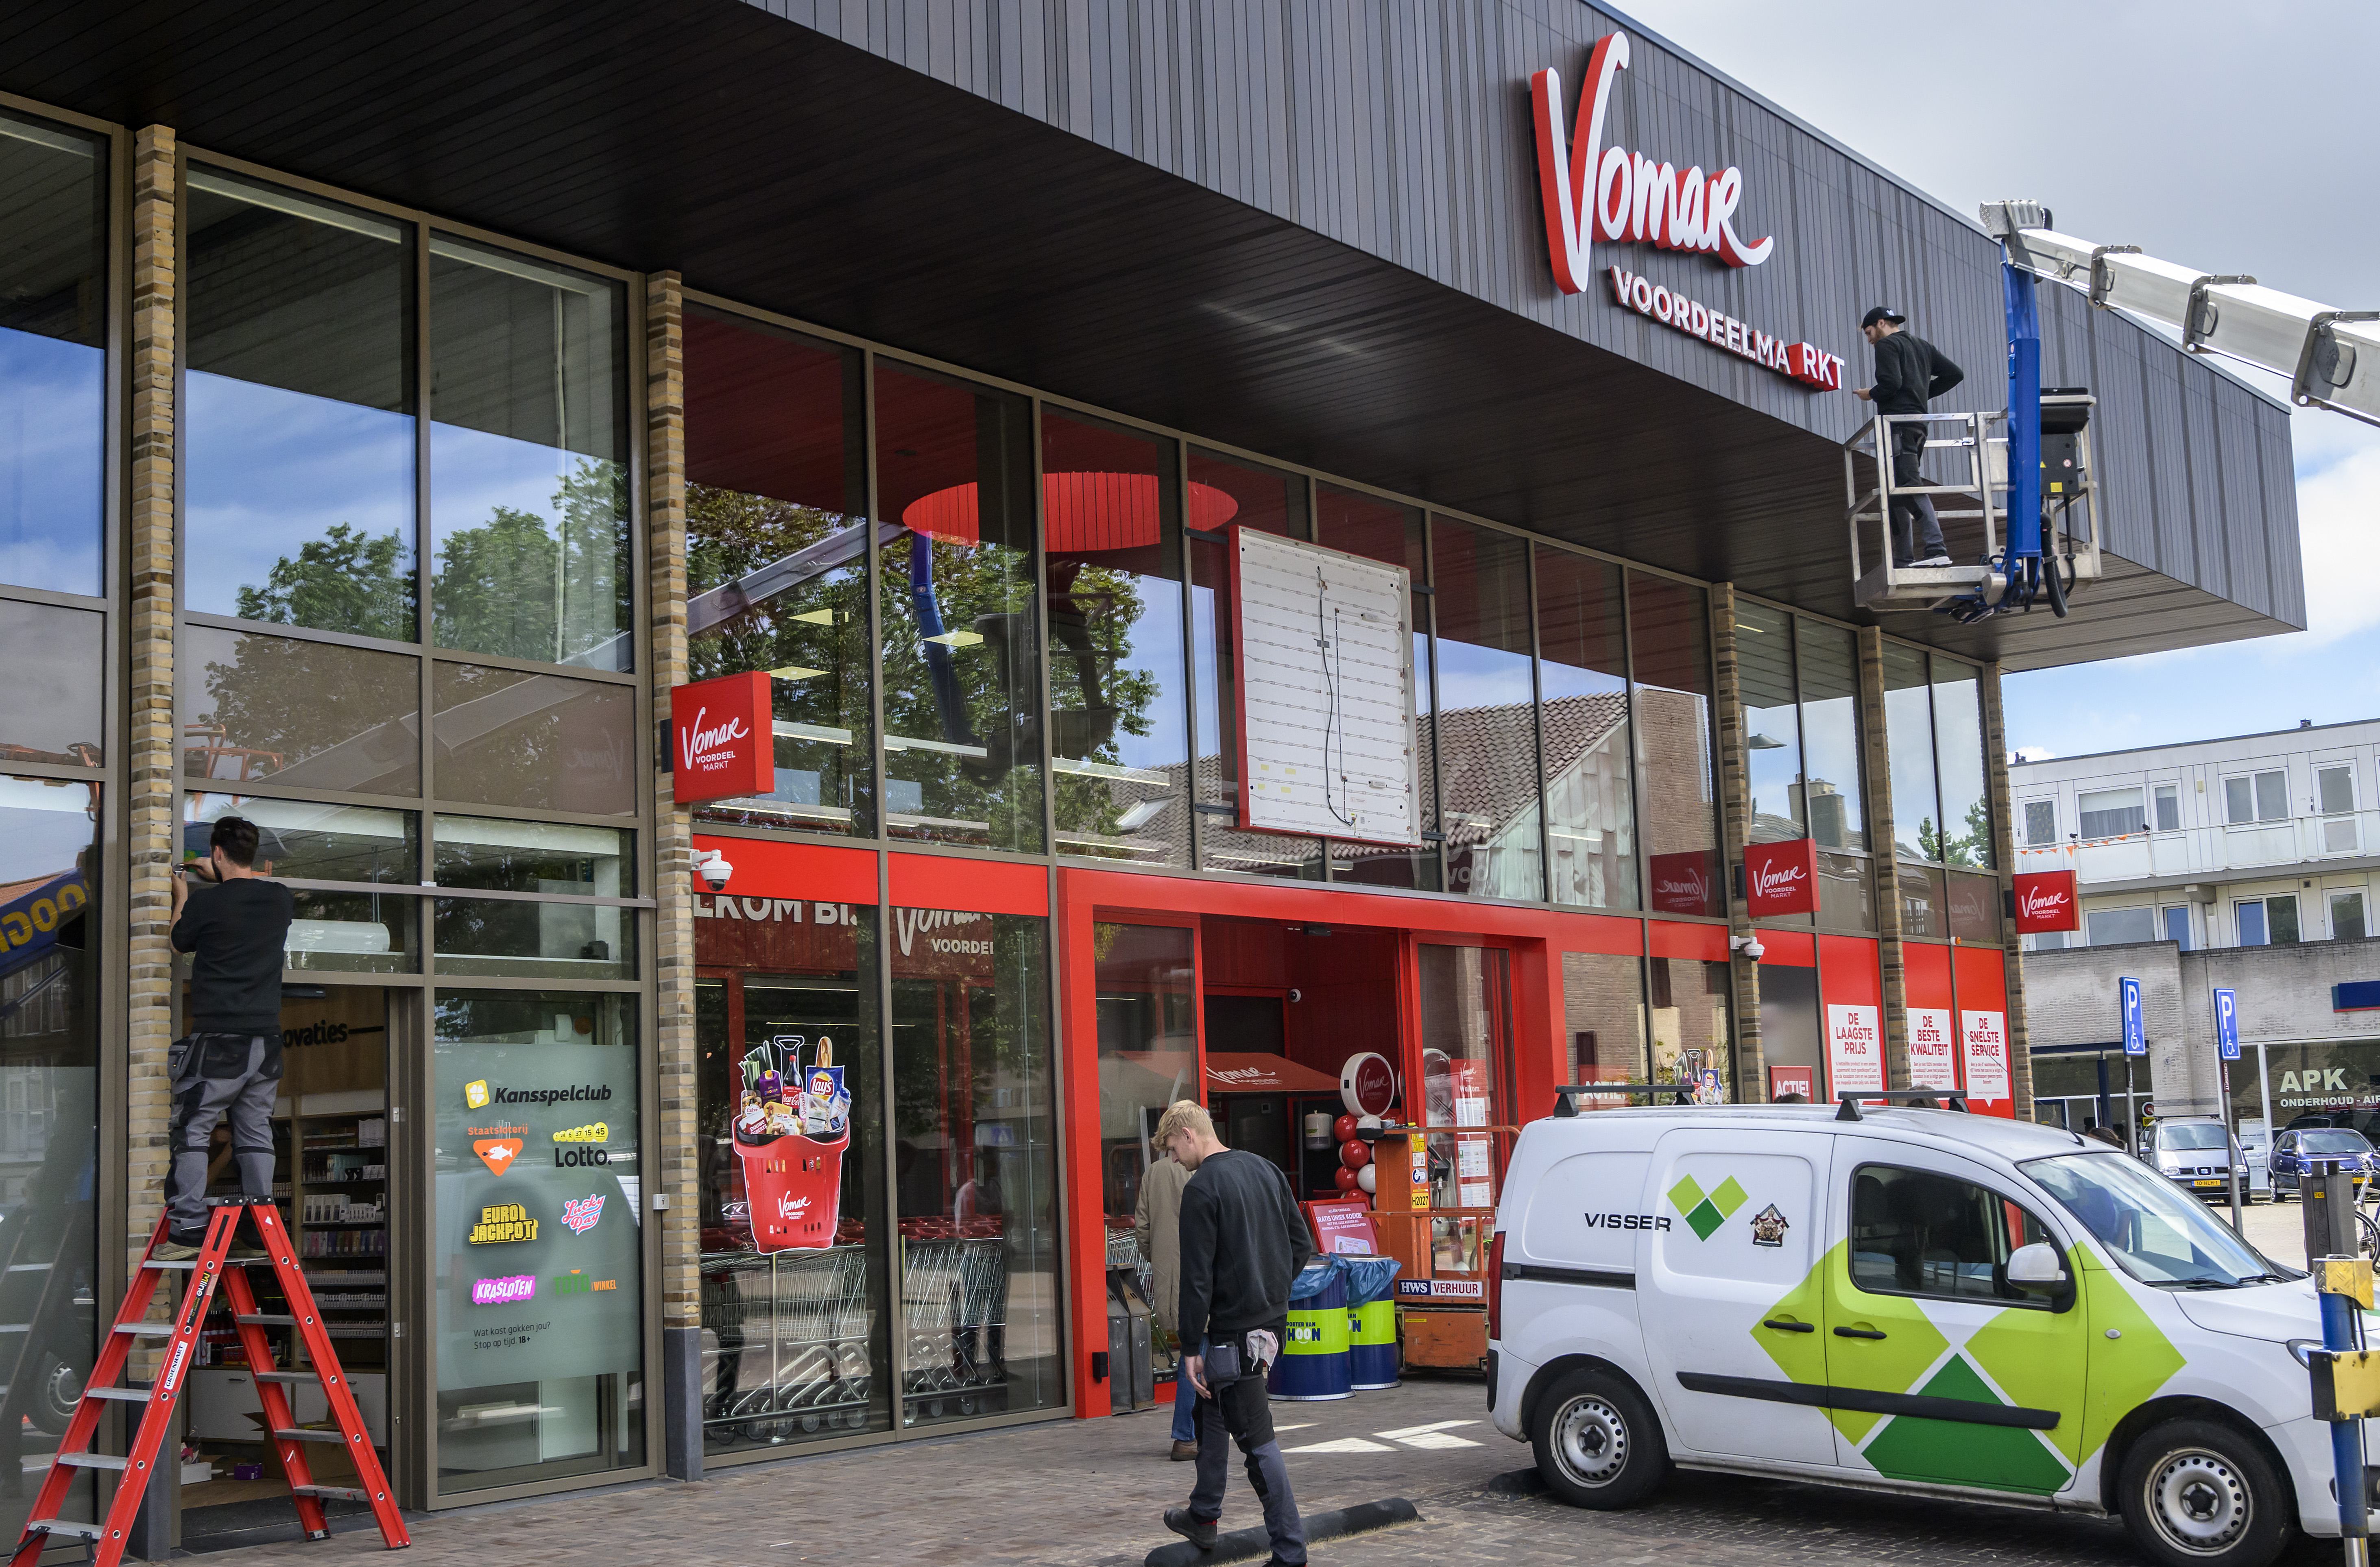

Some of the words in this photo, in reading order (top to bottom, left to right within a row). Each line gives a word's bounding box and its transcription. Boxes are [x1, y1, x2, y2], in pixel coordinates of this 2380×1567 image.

[1532, 31, 1774, 295] Vomar
[682, 707, 749, 770] Vomar
[696, 751, 736, 764] VOORDEEL
[703, 761, 729, 772] MARKT
[1753, 859, 1806, 897] Vomar
[2021, 886, 2069, 918] Vomar
[2128, 985, 2138, 1021] P
[2222, 995, 2232, 1029] P
[1848, 1013, 1859, 1025] DE
[1923, 1016, 1933, 1027] DE
[1979, 1018, 1988, 1029] DE
[1836, 1027, 1872, 1040] LAAGSTE
[1917, 1029, 1940, 1042] BESTE
[1970, 1031, 1999, 1043] SNELSTE
[1844, 1042, 1866, 1054] PRIJS
[1910, 1043, 1948, 1056] KWALITEIT
[1972, 1044, 1999, 1056] SERVICE
[811, 1078, 833, 1095] Lay's
[1359, 1068, 1389, 1099] Vomar
[1775, 1080, 1809, 1097] ACTIE!
[2280, 1068, 2348, 1092] APK
[495, 1085, 612, 1107] Kansspelclub
[2280, 1096, 2354, 1107] ONDERHOUD
[468, 1123, 528, 1135] Staatsloterij
[555, 1146, 612, 1168] Lotto.
[562, 1194, 605, 1223] Lucky
[778, 1190, 811, 1218] Vomar
[1412, 1196, 1428, 1206] H2027
[482, 1204, 519, 1224] EURO
[1584, 1213, 1671, 1232] VISSER
[470, 1220, 533, 1242] JACKPOT
[570, 1213, 600, 1234] Day
[476, 1279, 533, 1300] KRASLOTEN
[553, 1274, 589, 1295] TOTO
[593, 1279, 616, 1291] WINKEL
[1401, 1282, 1427, 1293] HWS
[1433, 1283, 1478, 1294] VERHUUR
[474, 1329, 489, 1337] Wat
[491, 1327, 506, 1335] kost
[508, 1324, 534, 1336] gokken
[535, 1321, 550, 1332] jou?
[474, 1341, 491, 1349] Stop
[504, 1337, 517, 1348] tijd.
[518, 1336, 530, 1344] 18+
[166, 1344, 183, 1387] GROENHART
